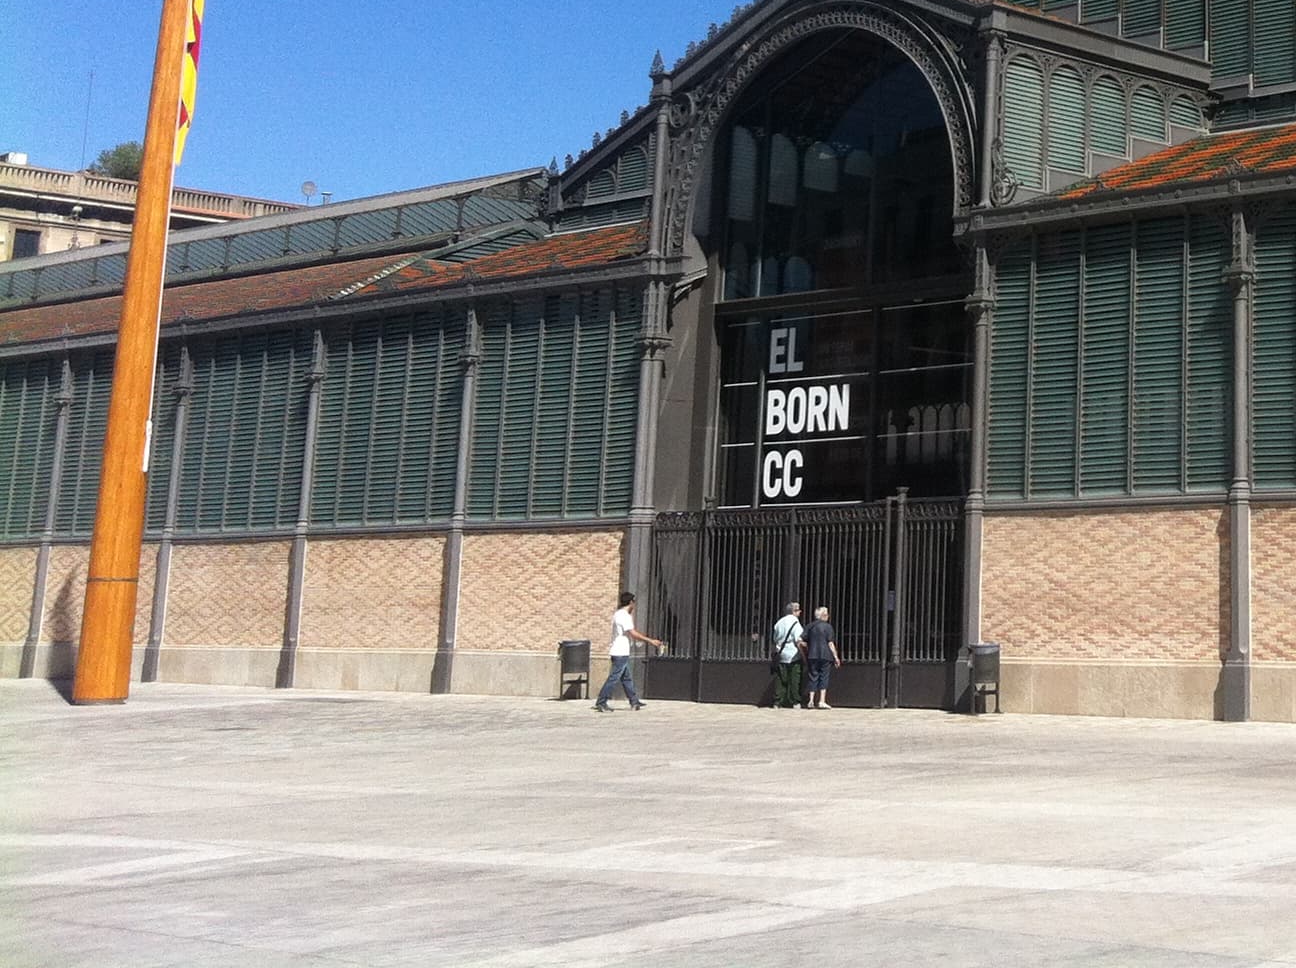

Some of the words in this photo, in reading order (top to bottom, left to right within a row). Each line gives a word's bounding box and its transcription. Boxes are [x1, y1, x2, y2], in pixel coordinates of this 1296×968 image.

[769, 328, 803, 373] EL
[765, 384, 850, 435] BORN
[763, 449, 803, 498] CC
